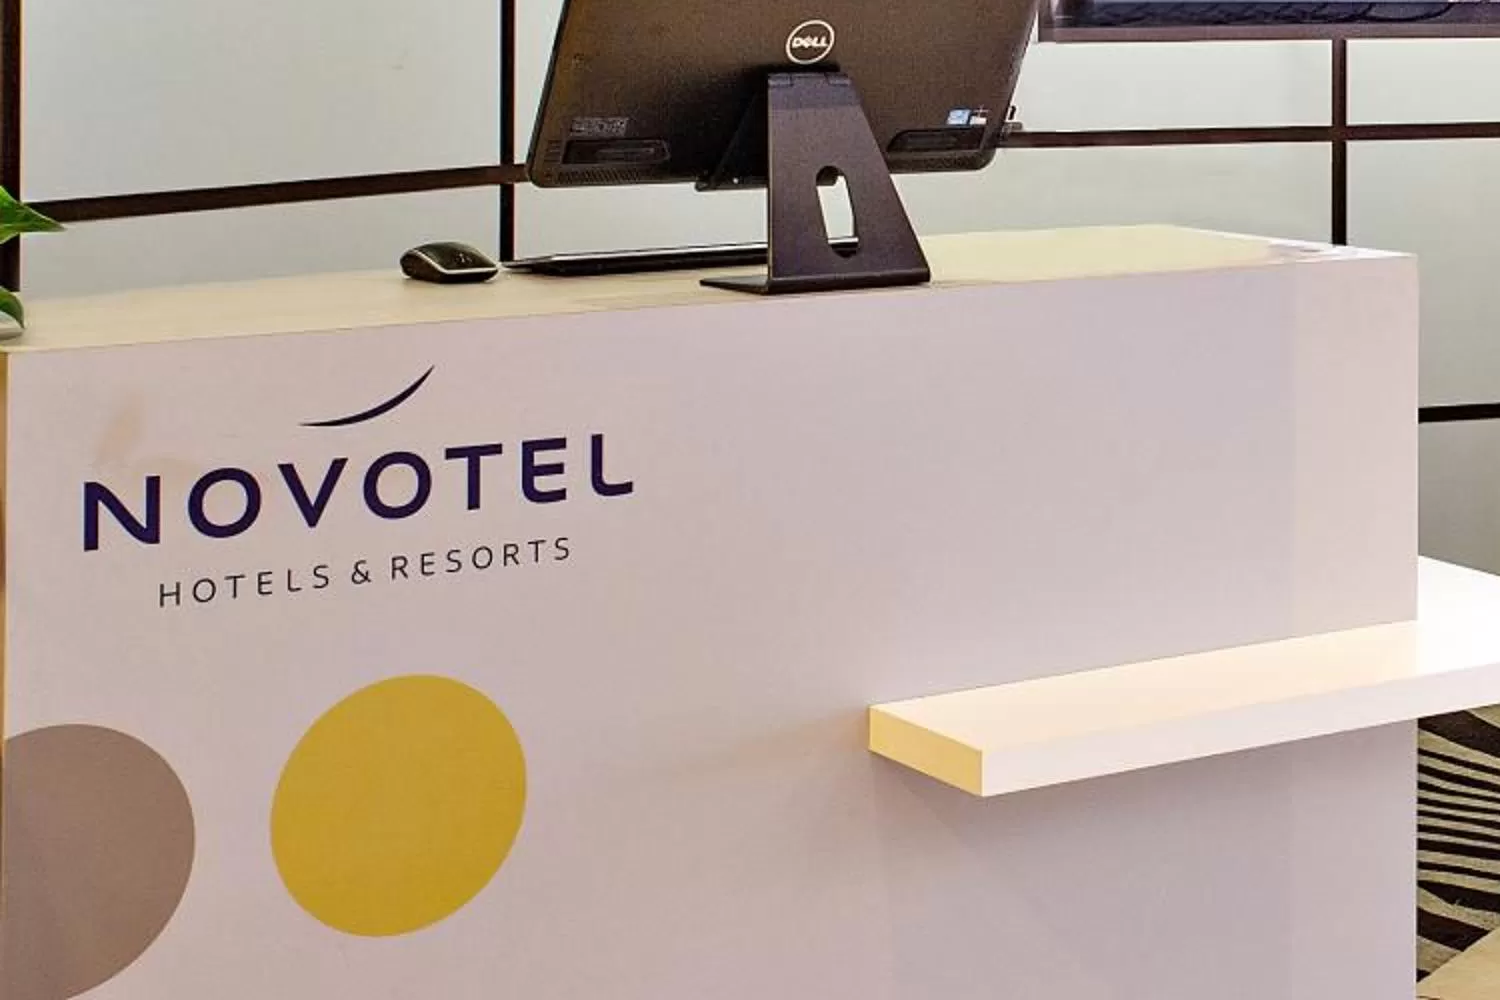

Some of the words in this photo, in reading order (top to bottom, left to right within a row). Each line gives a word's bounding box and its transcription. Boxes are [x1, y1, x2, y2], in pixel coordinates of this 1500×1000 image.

[792, 35, 829, 49] DELL
[83, 433, 634, 552] NOVOTEL
[157, 564, 331, 608] HOTELS
[350, 560, 373, 586] &
[390, 536, 572, 580] RESORTS
